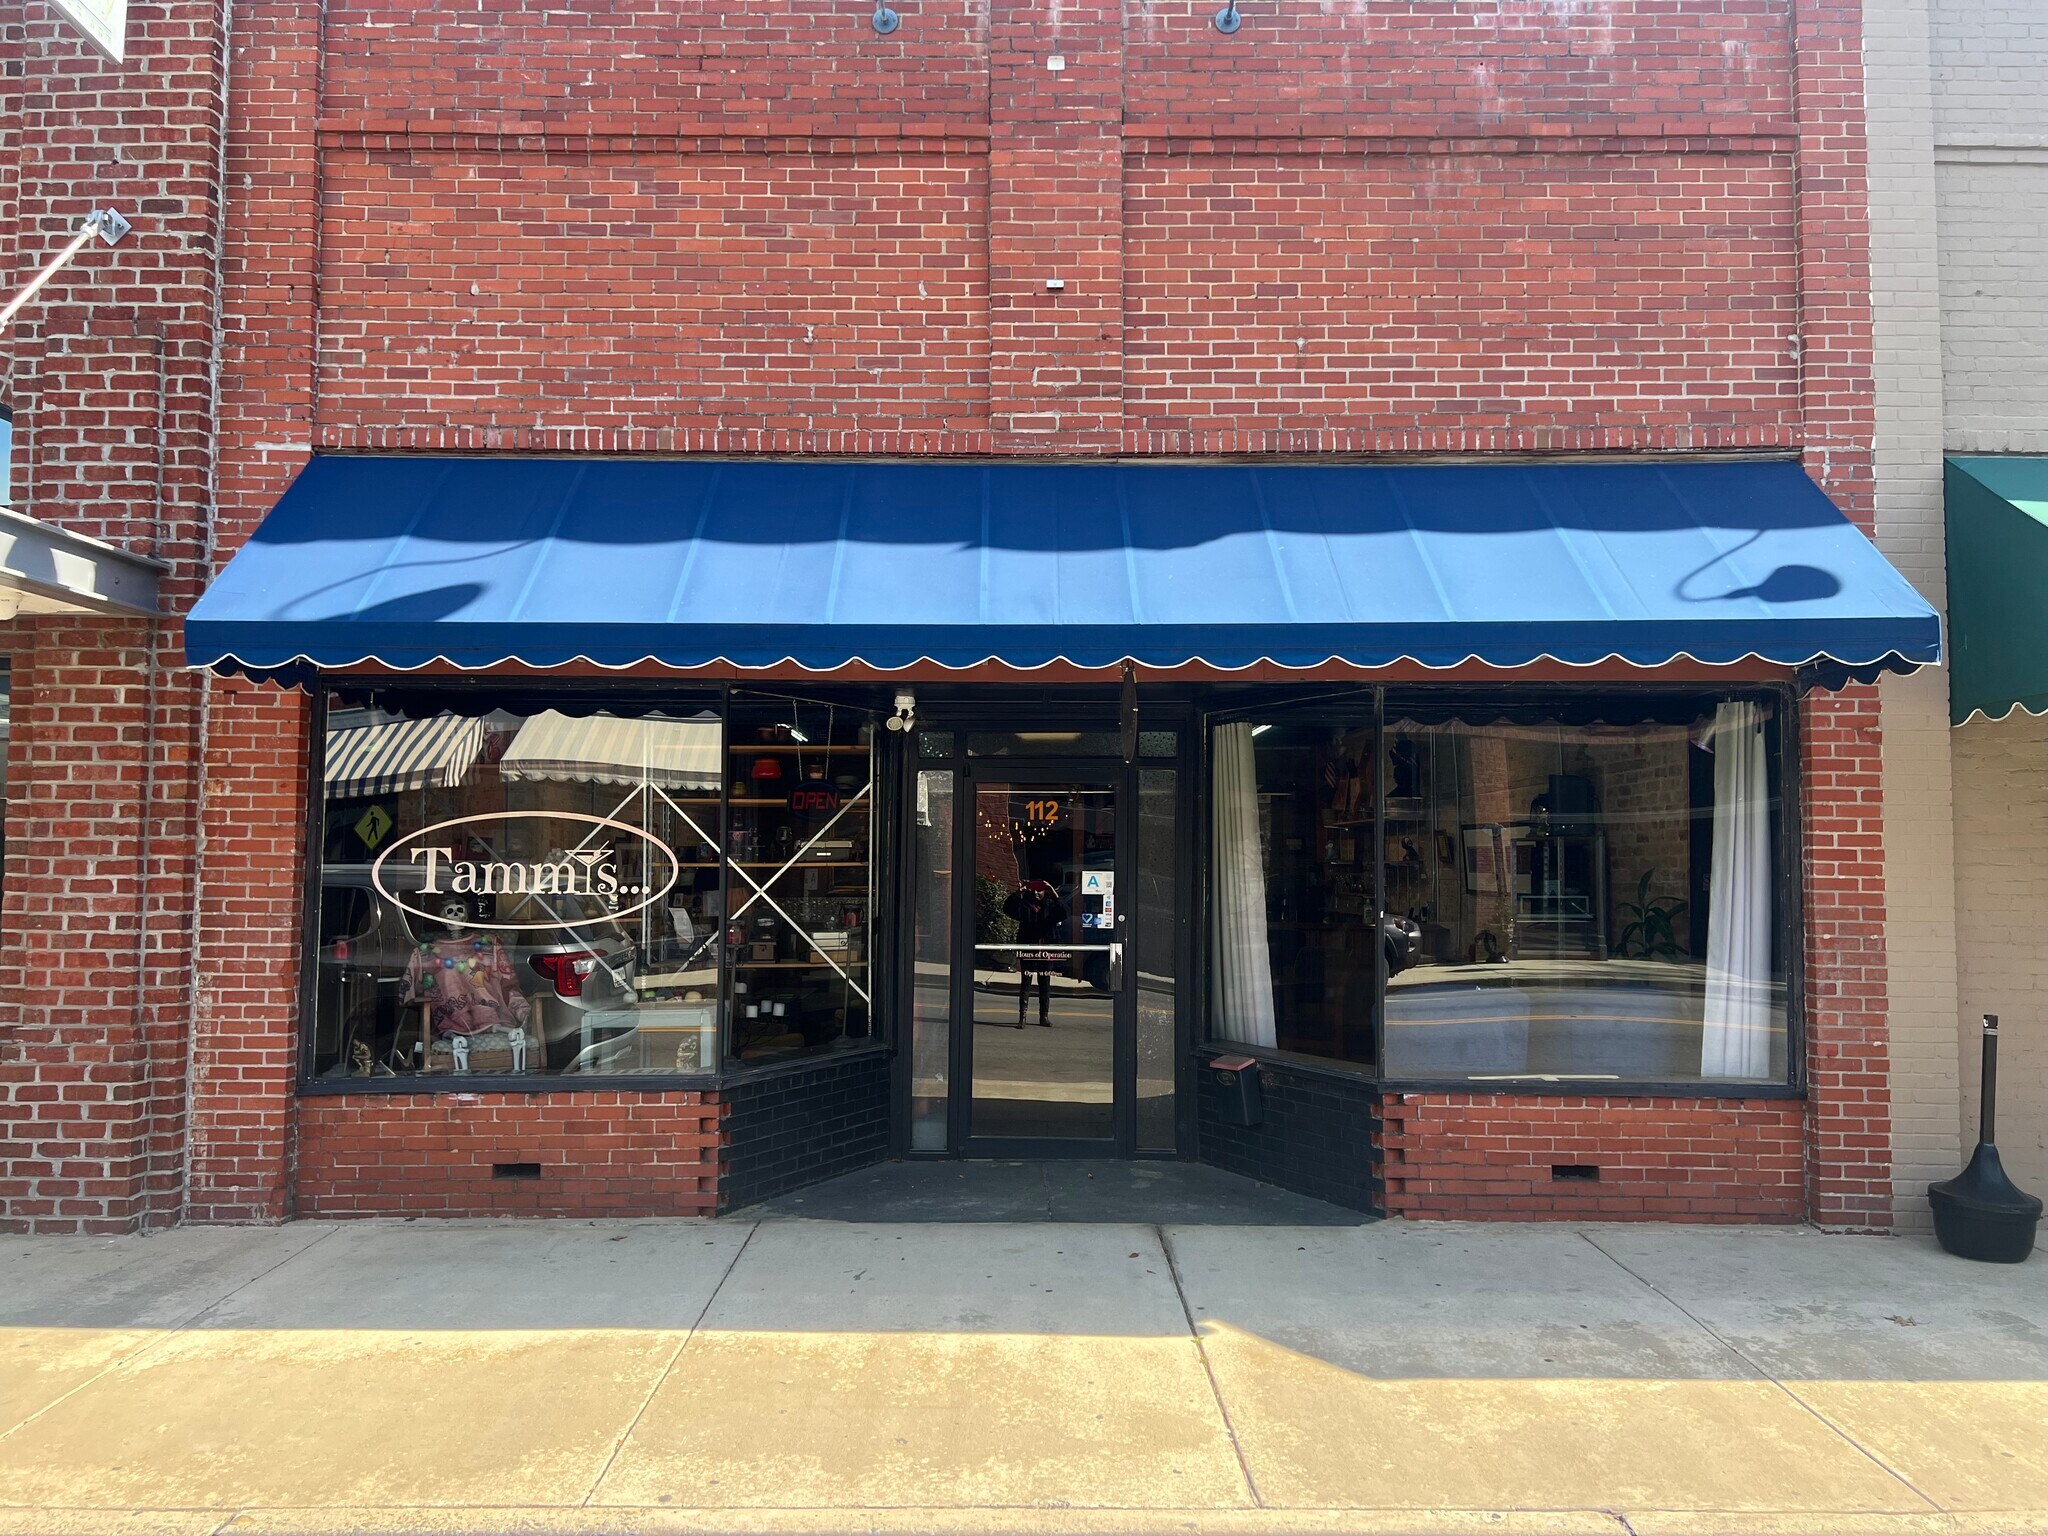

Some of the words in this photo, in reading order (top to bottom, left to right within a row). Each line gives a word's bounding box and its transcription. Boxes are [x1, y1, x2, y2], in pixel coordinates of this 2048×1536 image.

[792, 791, 838, 810] OPEN
[1025, 801, 1059, 820] 112
[1087, 875, 1099, 888] A
[1042, 951, 1072, 960] Operation
